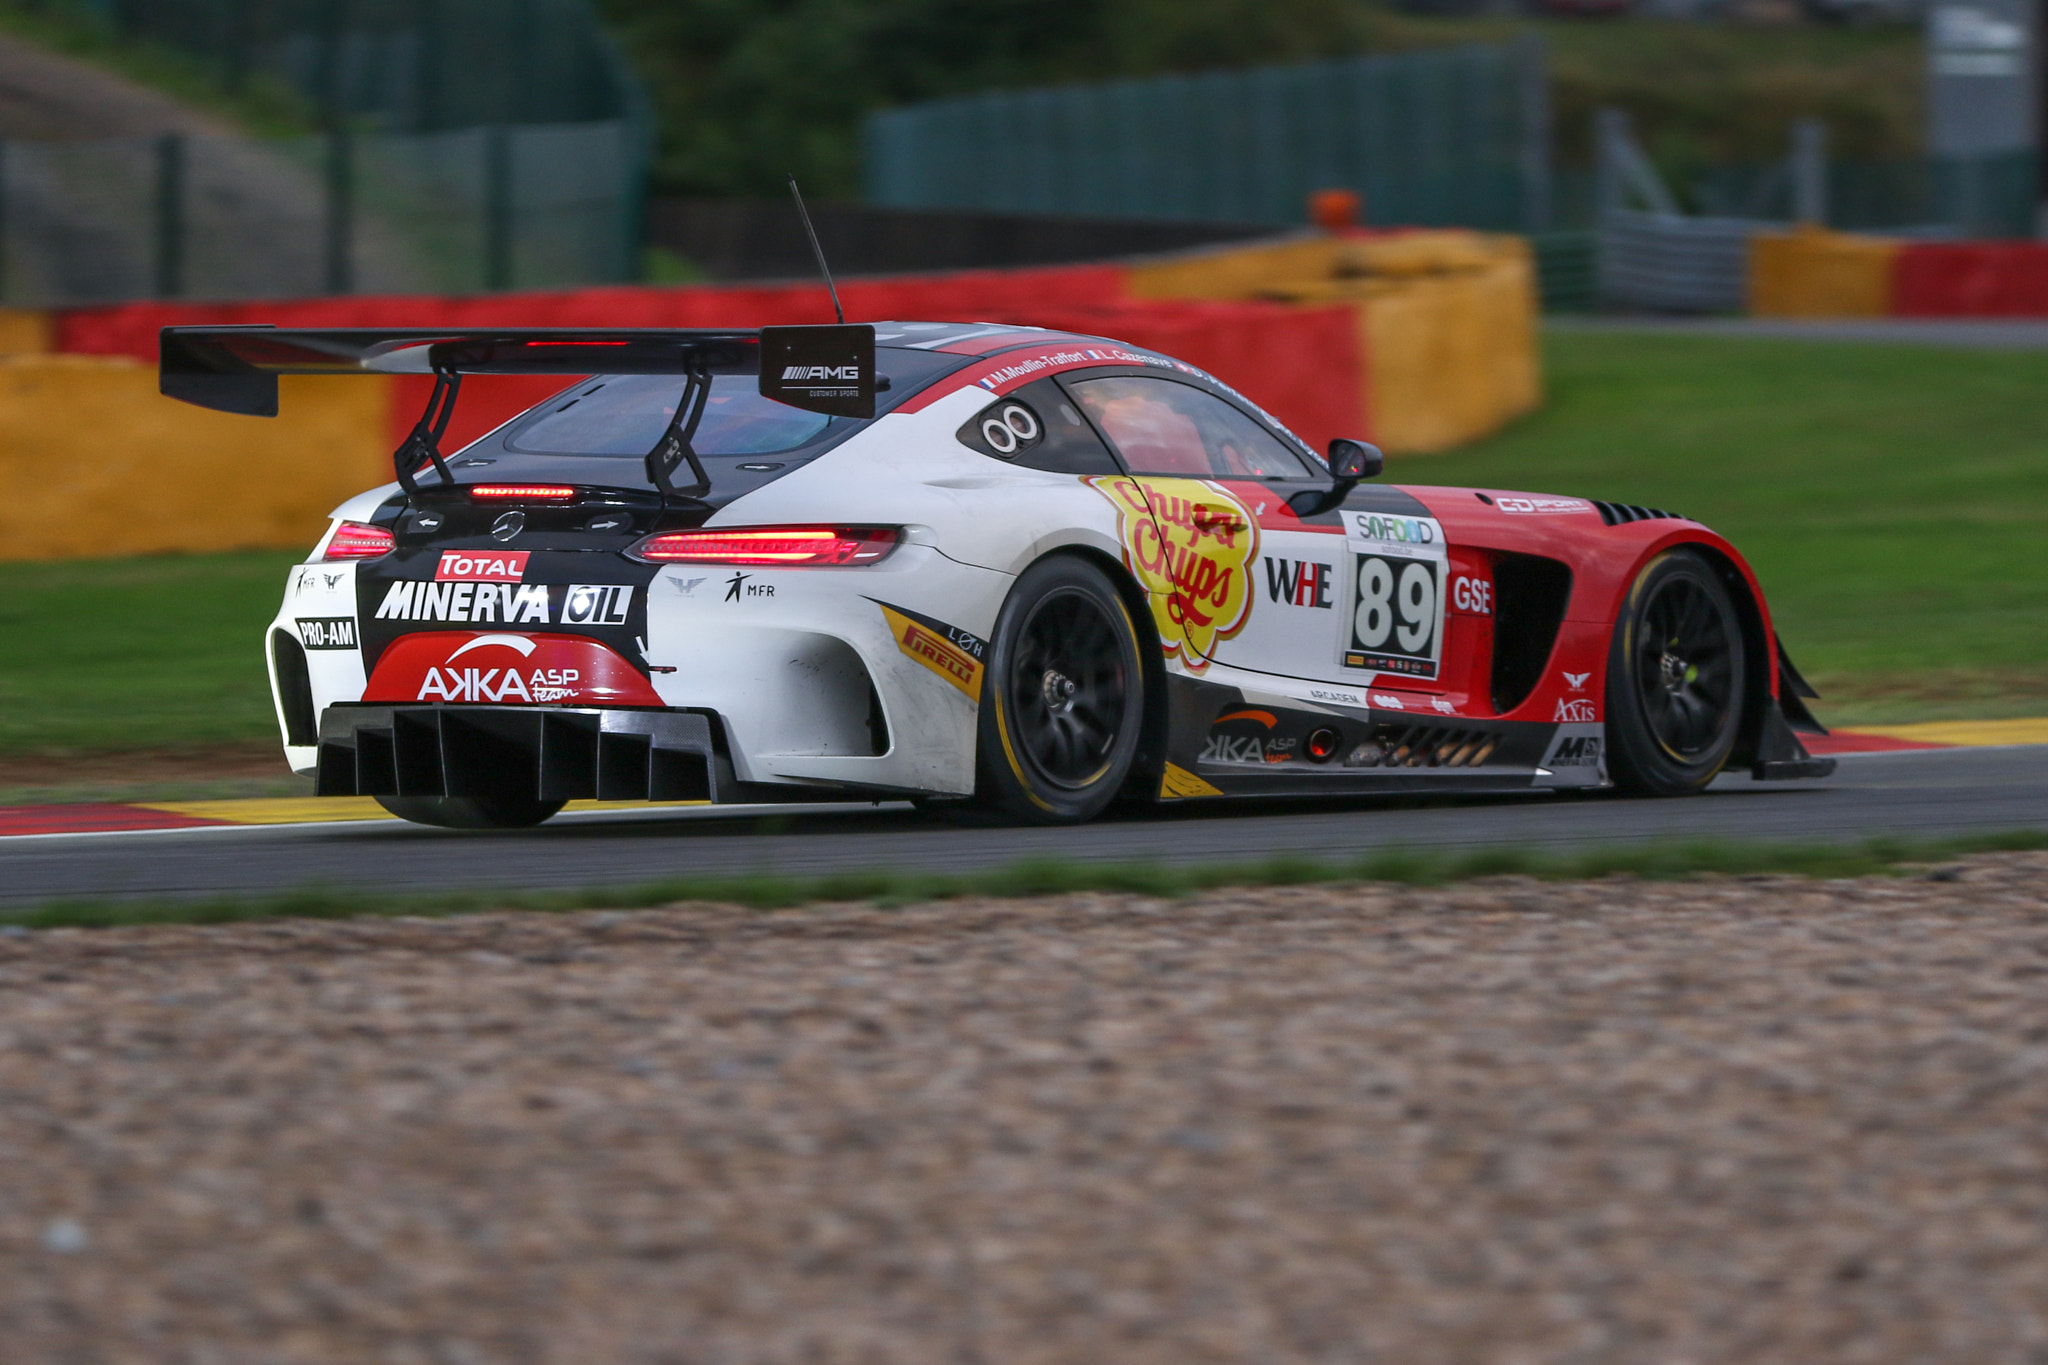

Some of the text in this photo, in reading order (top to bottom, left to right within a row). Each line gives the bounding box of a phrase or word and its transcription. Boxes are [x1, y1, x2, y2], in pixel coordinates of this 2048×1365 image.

[806, 366, 859, 380] AMG
[1114, 481, 1243, 549] Chupa
[441, 554, 524, 577] TOTAL
[1134, 518, 1234, 626] Chups
[1264, 556, 1333, 609] WHE
[374, 580, 627, 624] MINERVA OIL
[747, 585, 775, 597] MFR
[1355, 557, 1435, 653] 89
[1454, 576, 1491, 614] GSE
[299, 621, 354, 646] PRO-AM
[902, 623, 976, 685] PIRELLI
[416, 666, 580, 702] AKKA ASP
[1264, 738, 1297, 750] ASP
